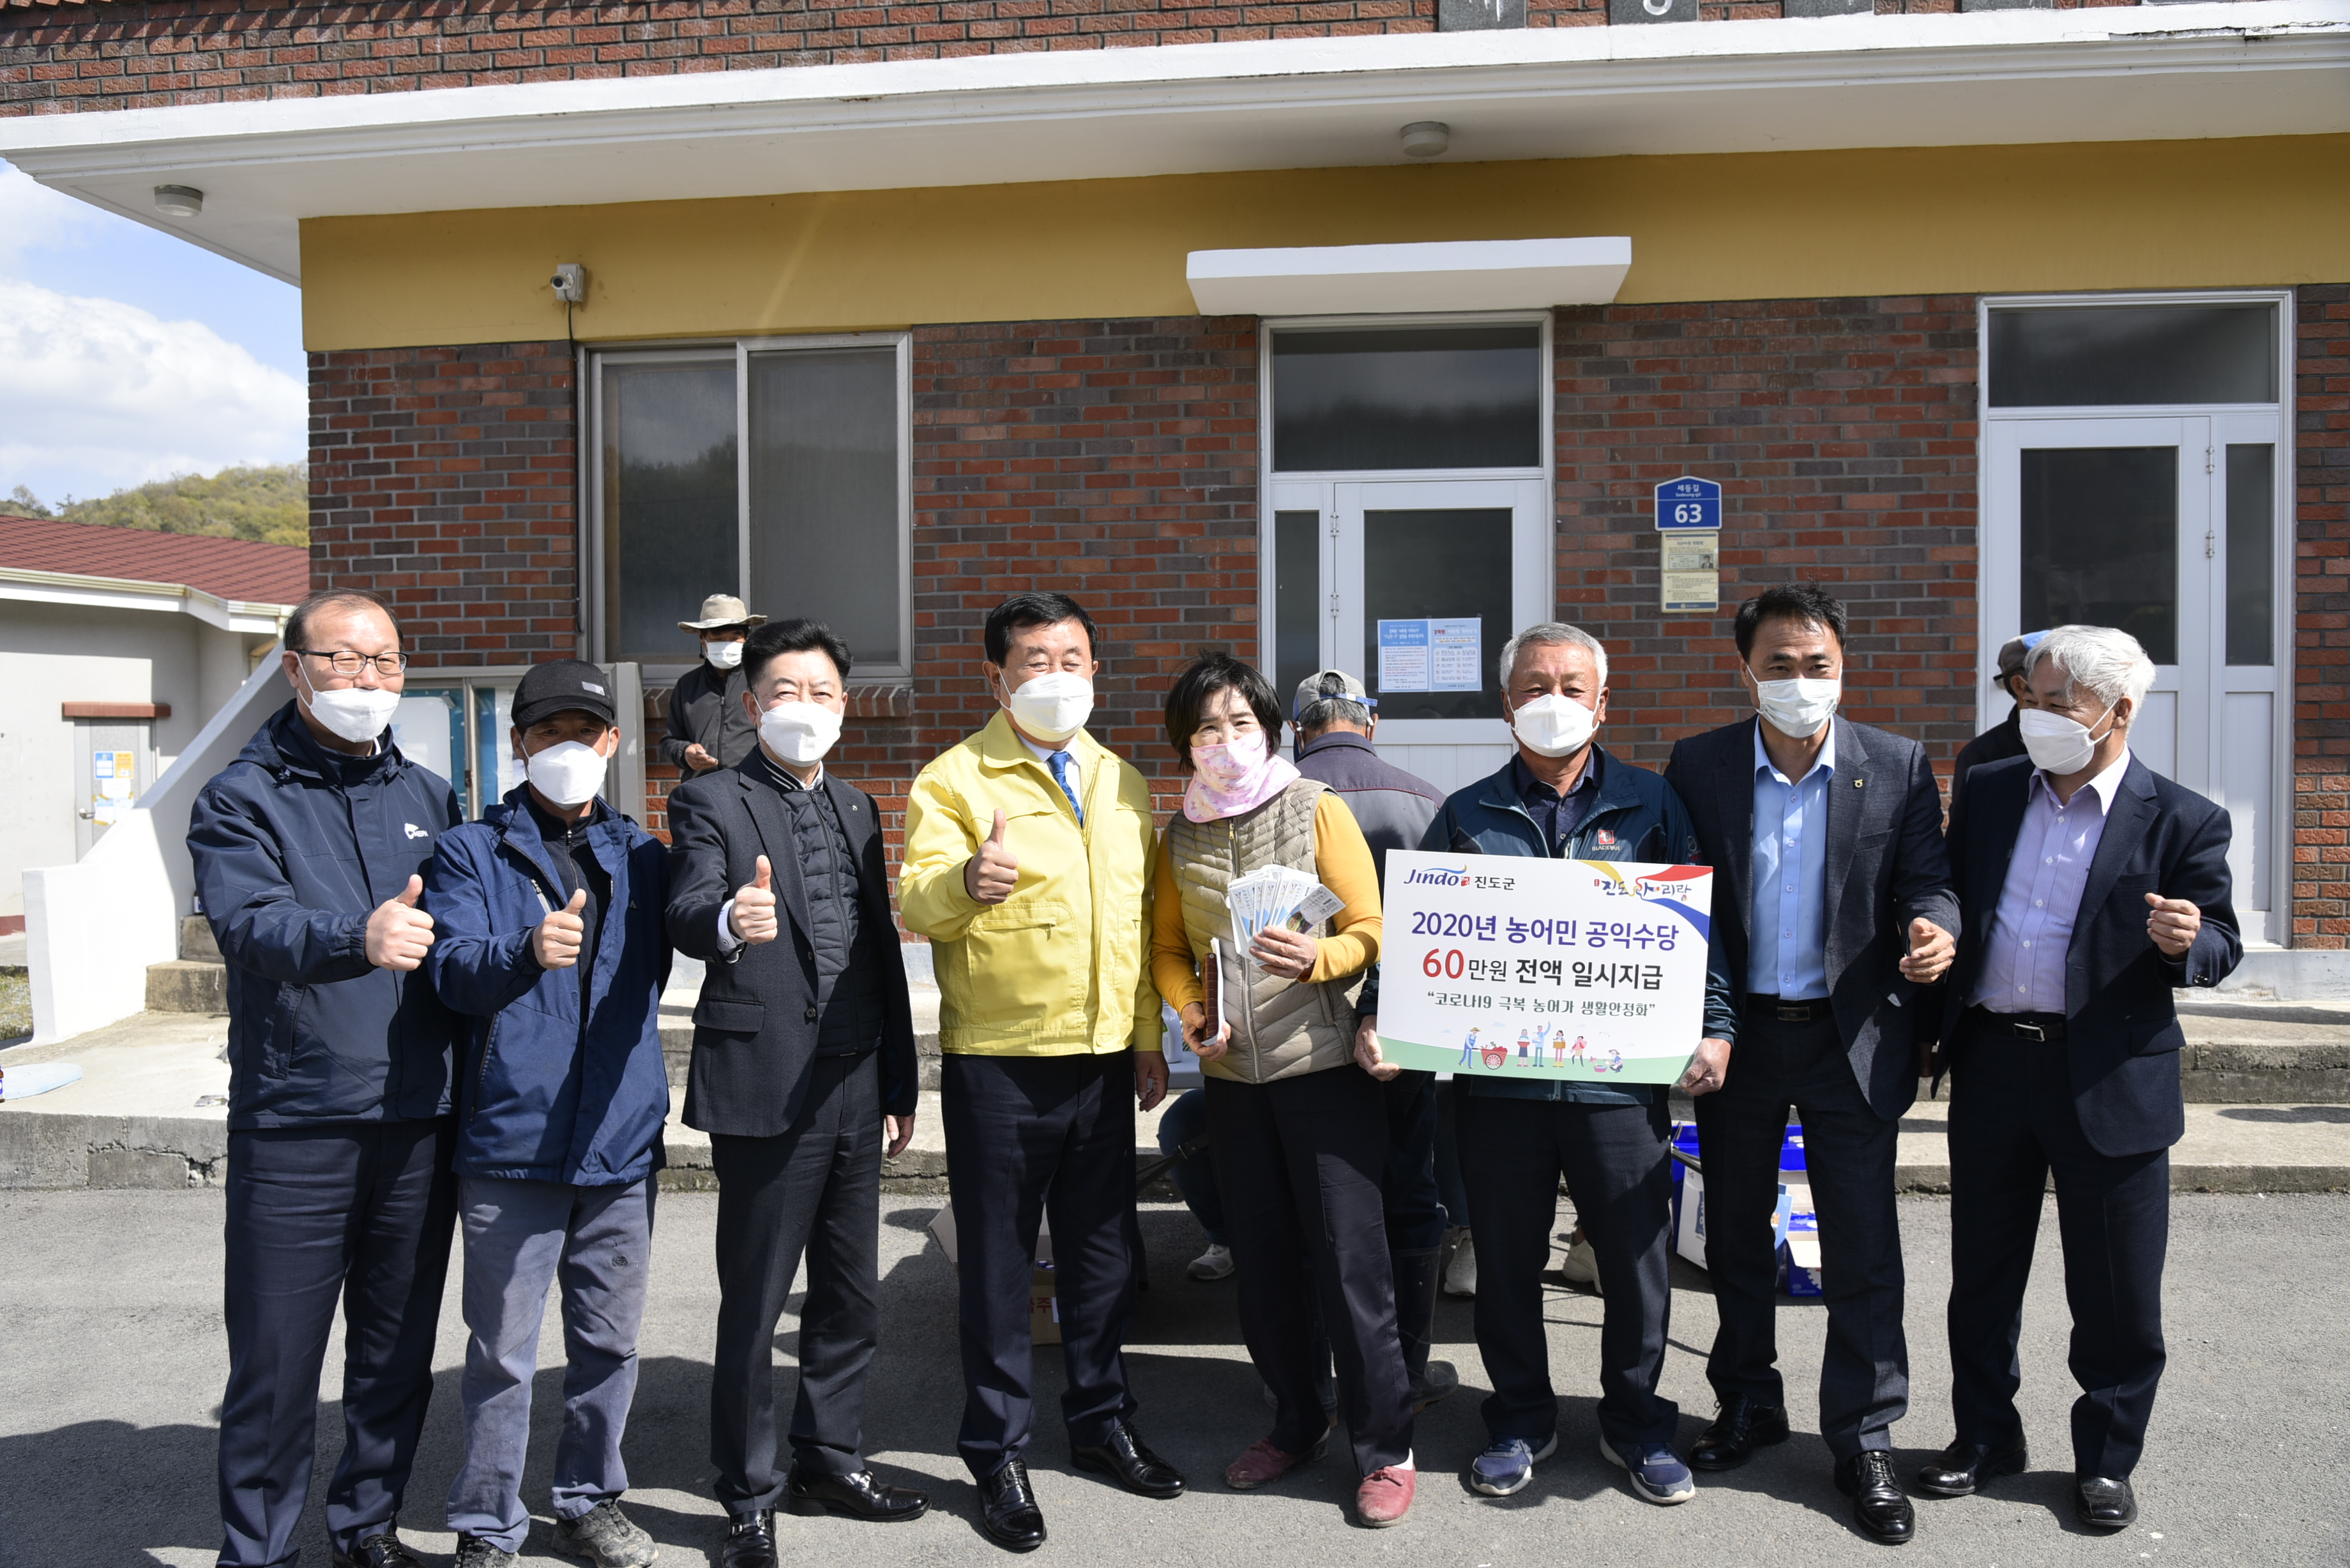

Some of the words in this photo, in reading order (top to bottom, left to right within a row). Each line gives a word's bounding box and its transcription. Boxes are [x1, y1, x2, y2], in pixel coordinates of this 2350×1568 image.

[1674, 504, 1702, 524] 63
[1404, 869, 1459, 886] Jindo
[1474, 876, 1515, 891] 진도군
[1411, 912, 1497, 942] 2020년
[1505, 916, 1577, 946] 농어민
[1585, 922, 1679, 951] 공익수당
[1423, 948, 1507, 982] 60만원
[1515, 958, 1562, 986] 전액
[1572, 961, 1664, 990] 일시지급
[1499, 996, 1526, 1012] 극복
[1533, 999, 1574, 1014] 농어가
